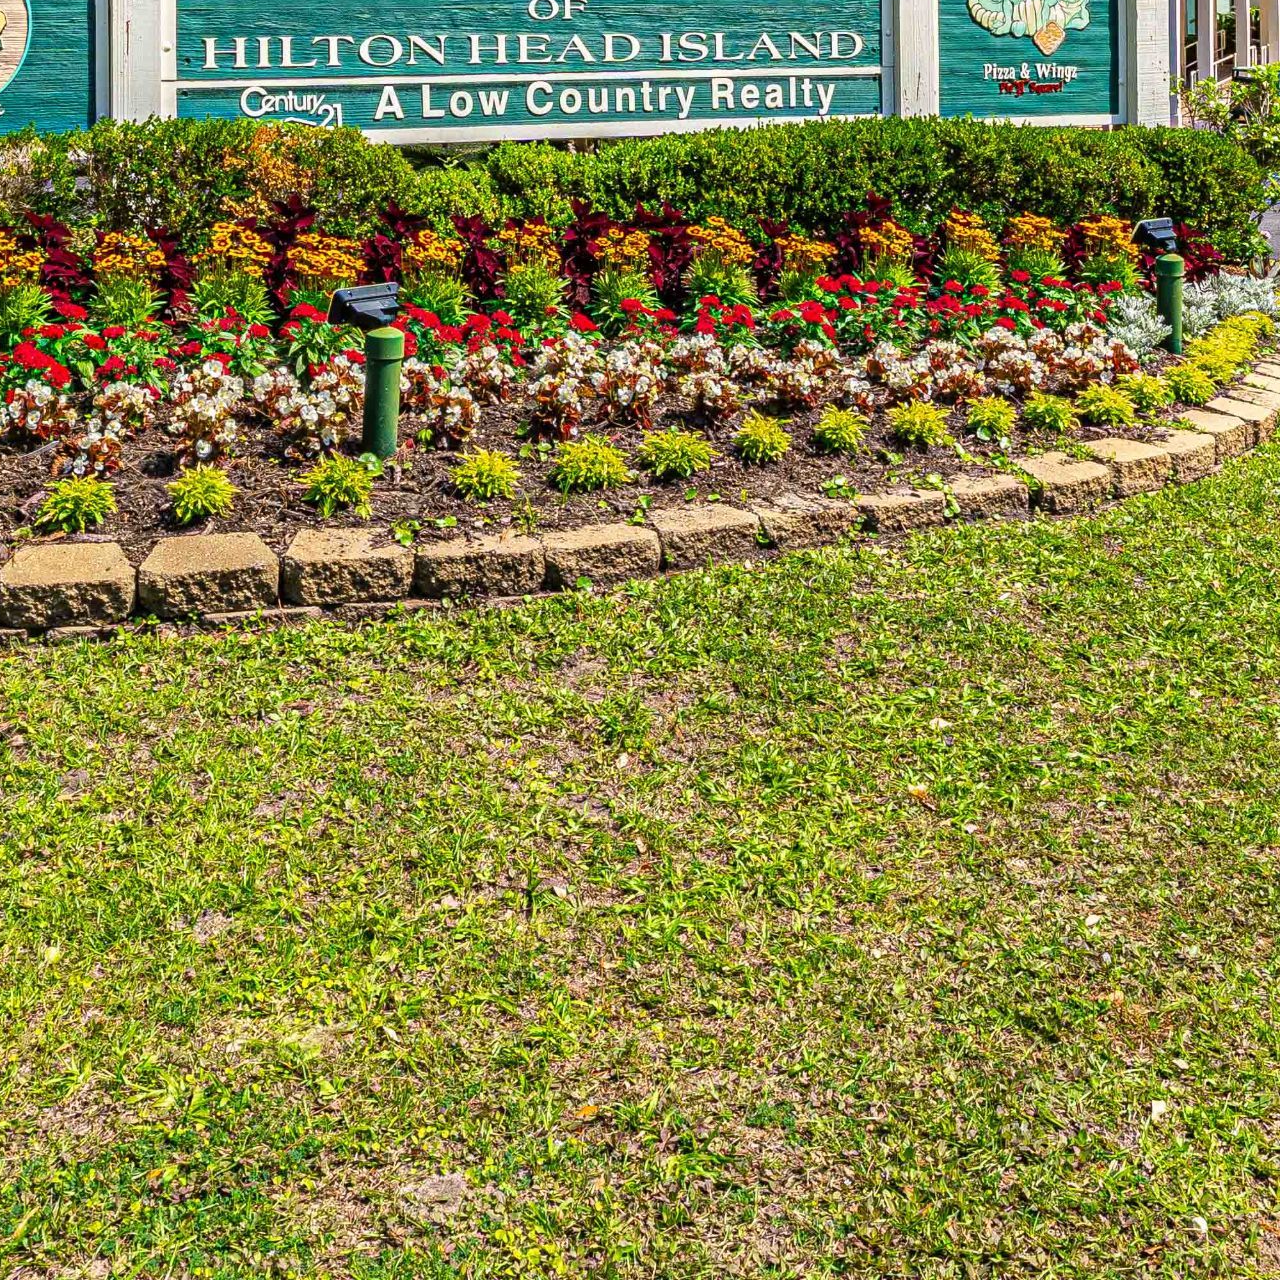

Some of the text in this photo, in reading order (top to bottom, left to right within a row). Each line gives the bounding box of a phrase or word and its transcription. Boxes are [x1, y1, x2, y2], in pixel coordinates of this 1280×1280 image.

[202, 31, 864, 70] HILTON HEAD ISLAND
[984, 62, 1078, 82] Pizza & Wingz
[240, 86, 343, 130] Century 21
[374, 76, 837, 121] A Low Country Realty
